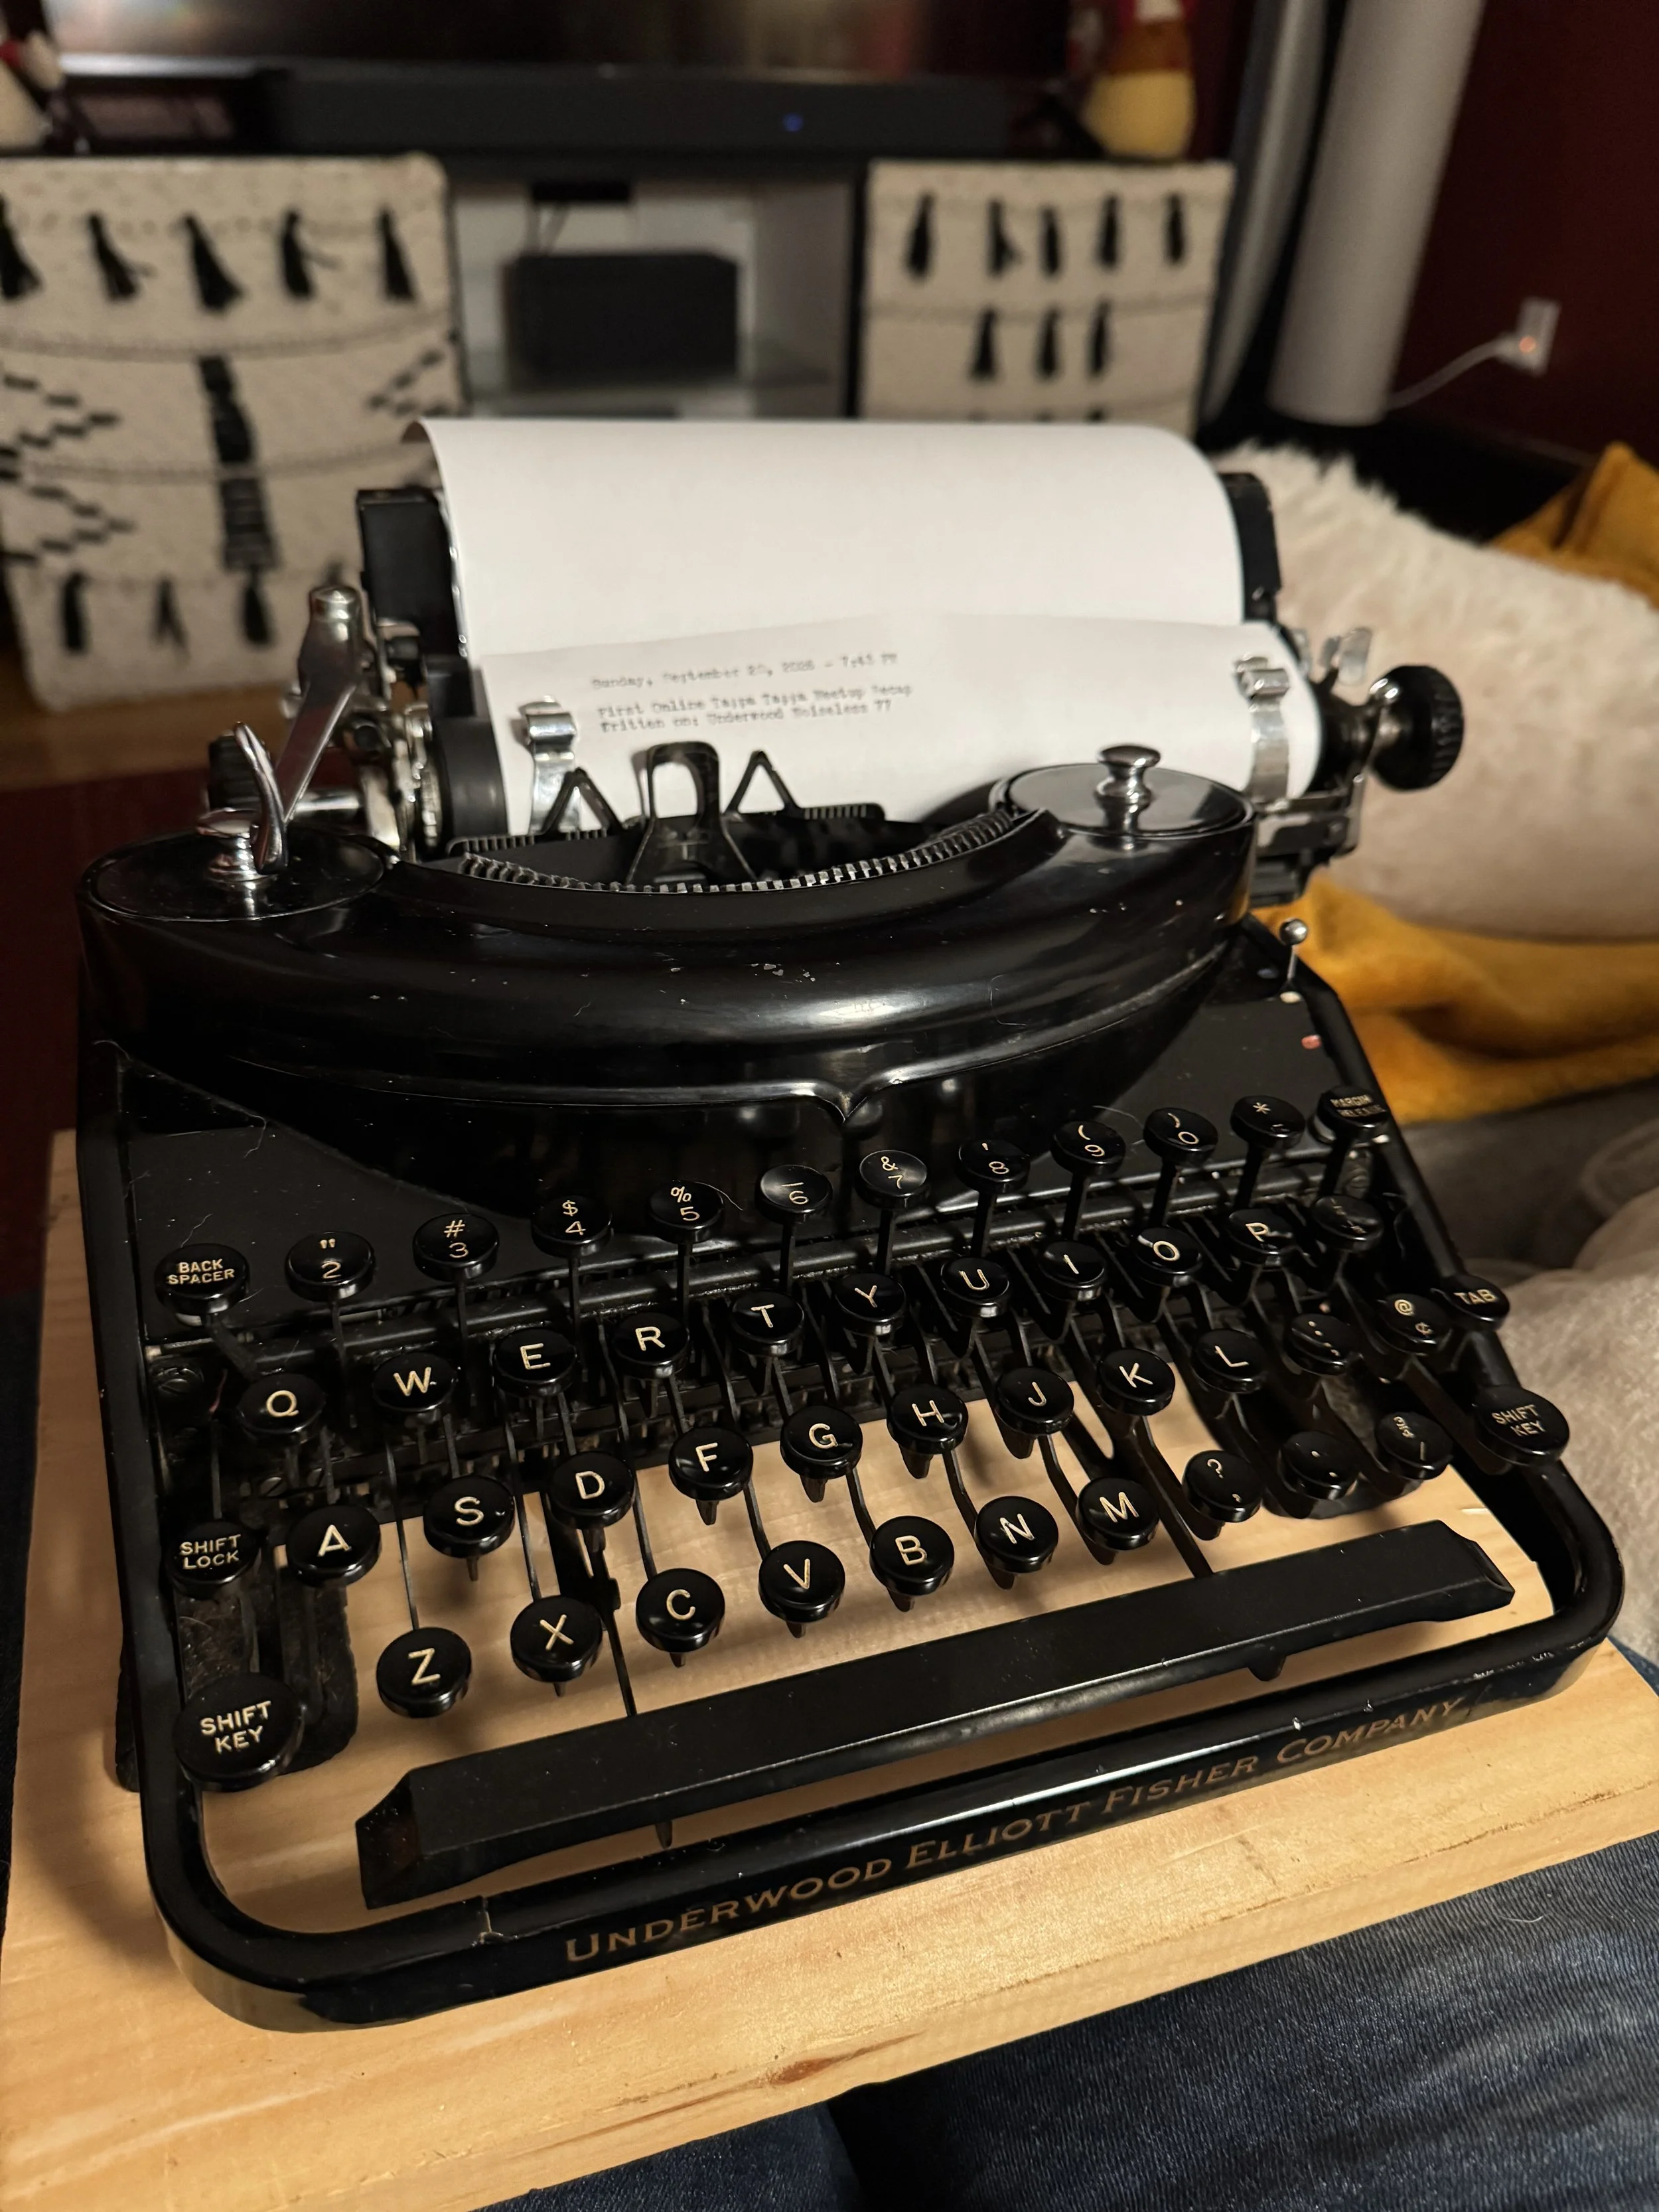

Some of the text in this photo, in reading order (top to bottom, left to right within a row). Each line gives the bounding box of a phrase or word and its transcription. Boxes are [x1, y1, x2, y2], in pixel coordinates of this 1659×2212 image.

[662, 669, 740, 683] September
[597, 702, 644, 718] First
[652, 700, 705, 713] Online
[1085, 1145, 1104, 1156] 9
[881, 1156, 897, 1171] &
[989, 1161, 1009, 1174] 8
[888, 1174, 904, 1189] 7
[671, 1187, 691, 1203] %
[788, 1190, 809, 1205] 6
[563, 1200, 578, 1216] $
[680, 1207, 699, 1220] 5
[444, 1220, 465, 1237] #
[565, 1221, 586, 1235] 4
[1246, 1222, 1267, 1242] P
[449, 1242, 469, 1258] 3
[1152, 1240, 1180, 1261] O
[179, 1258, 224, 1274] BACK
[322, 1259, 340, 1278] 2
[1064, 1254, 1079, 1274] I
[168, 1268, 235, 1285] SPACER
[959, 1269, 989, 1290] U
[855, 1286, 877, 1307] Y
[1395, 1299, 1413, 1315] @
[1453, 1289, 1498, 1305] TAB
[751, 1304, 774, 1327] T
[636, 1327, 665, 1351] R
[520, 1343, 550, 1369] E
[1215, 1346, 1248, 1367] L
[394, 1367, 431, 1396] W
[1119, 1363, 1153, 1388] K
[266, 1390, 299, 1416] Q
[1029, 1382, 1046, 1406] J
[912, 1400, 944, 1426] H
[1491, 1404, 1539, 1425] SHIFT
[809, 1424, 838, 1448] G
[1510, 1420, 1546, 1436] KEY
[696, 1443, 717, 1471] F
[1207, 1458, 1224, 1479] ?
[575, 1471, 605, 1499] D
[455, 1497, 484, 1525] S
[1100, 1492, 1139, 1522] M
[1000, 1514, 1034, 1544] N
[180, 1534, 242, 1556] SHIFT
[319, 1524, 351, 1556] A
[895, 1536, 927, 1565] B
[182, 1550, 240, 1570] LOCK
[783, 1558, 811, 1591] V
[666, 1589, 695, 1619] C
[540, 1615, 573, 1649] X
[409, 1648, 440, 1684] Z
[200, 1700, 271, 1735] SHIFT
[214, 1726, 264, 1754] KEY
[566, 1696, 1465, 1962] UNDERWOOD ELLIOTT FISHER COMPANY
